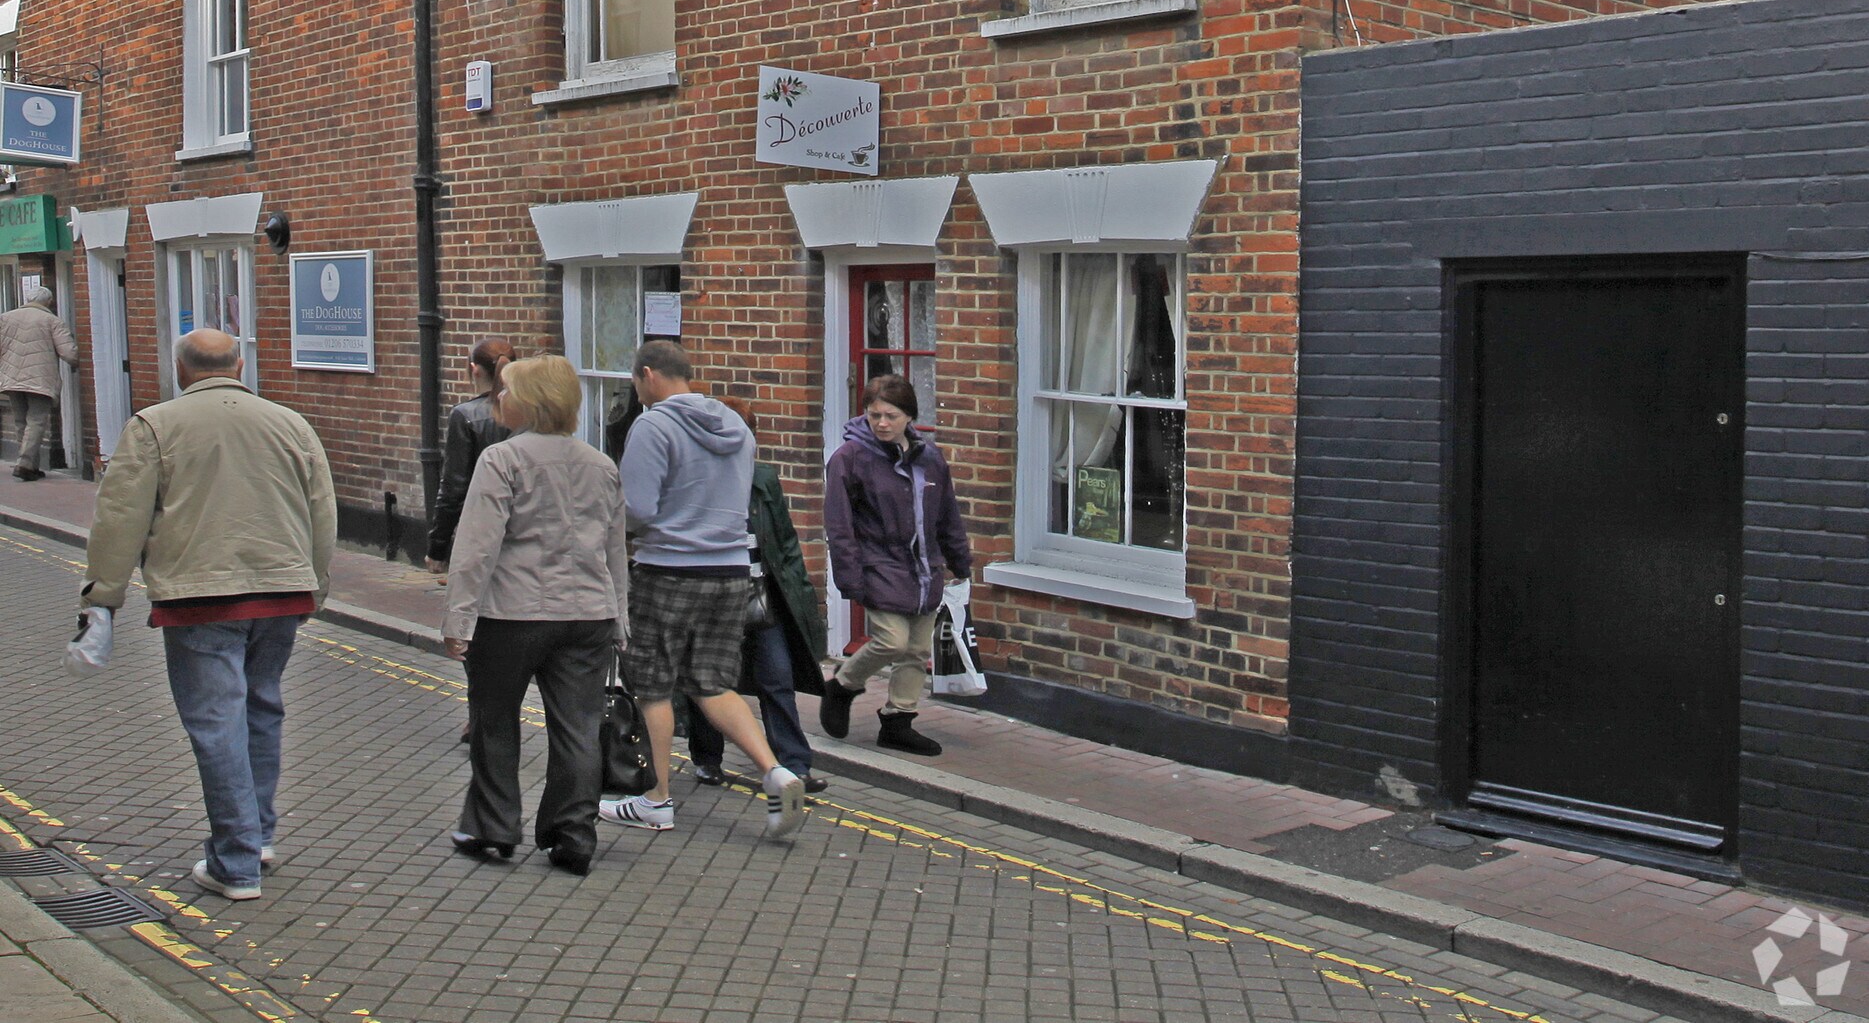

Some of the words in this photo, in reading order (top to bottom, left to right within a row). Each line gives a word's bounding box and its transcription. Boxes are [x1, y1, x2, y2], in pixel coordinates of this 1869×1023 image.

[468, 67, 481, 77] TDT
[764, 96, 873, 148] Découverte
[806, 149, 823, 158] Shop
[9, 201, 37, 226] CAFE
[301, 308, 315, 319] THE
[1079, 469, 1106, 488] Pears
